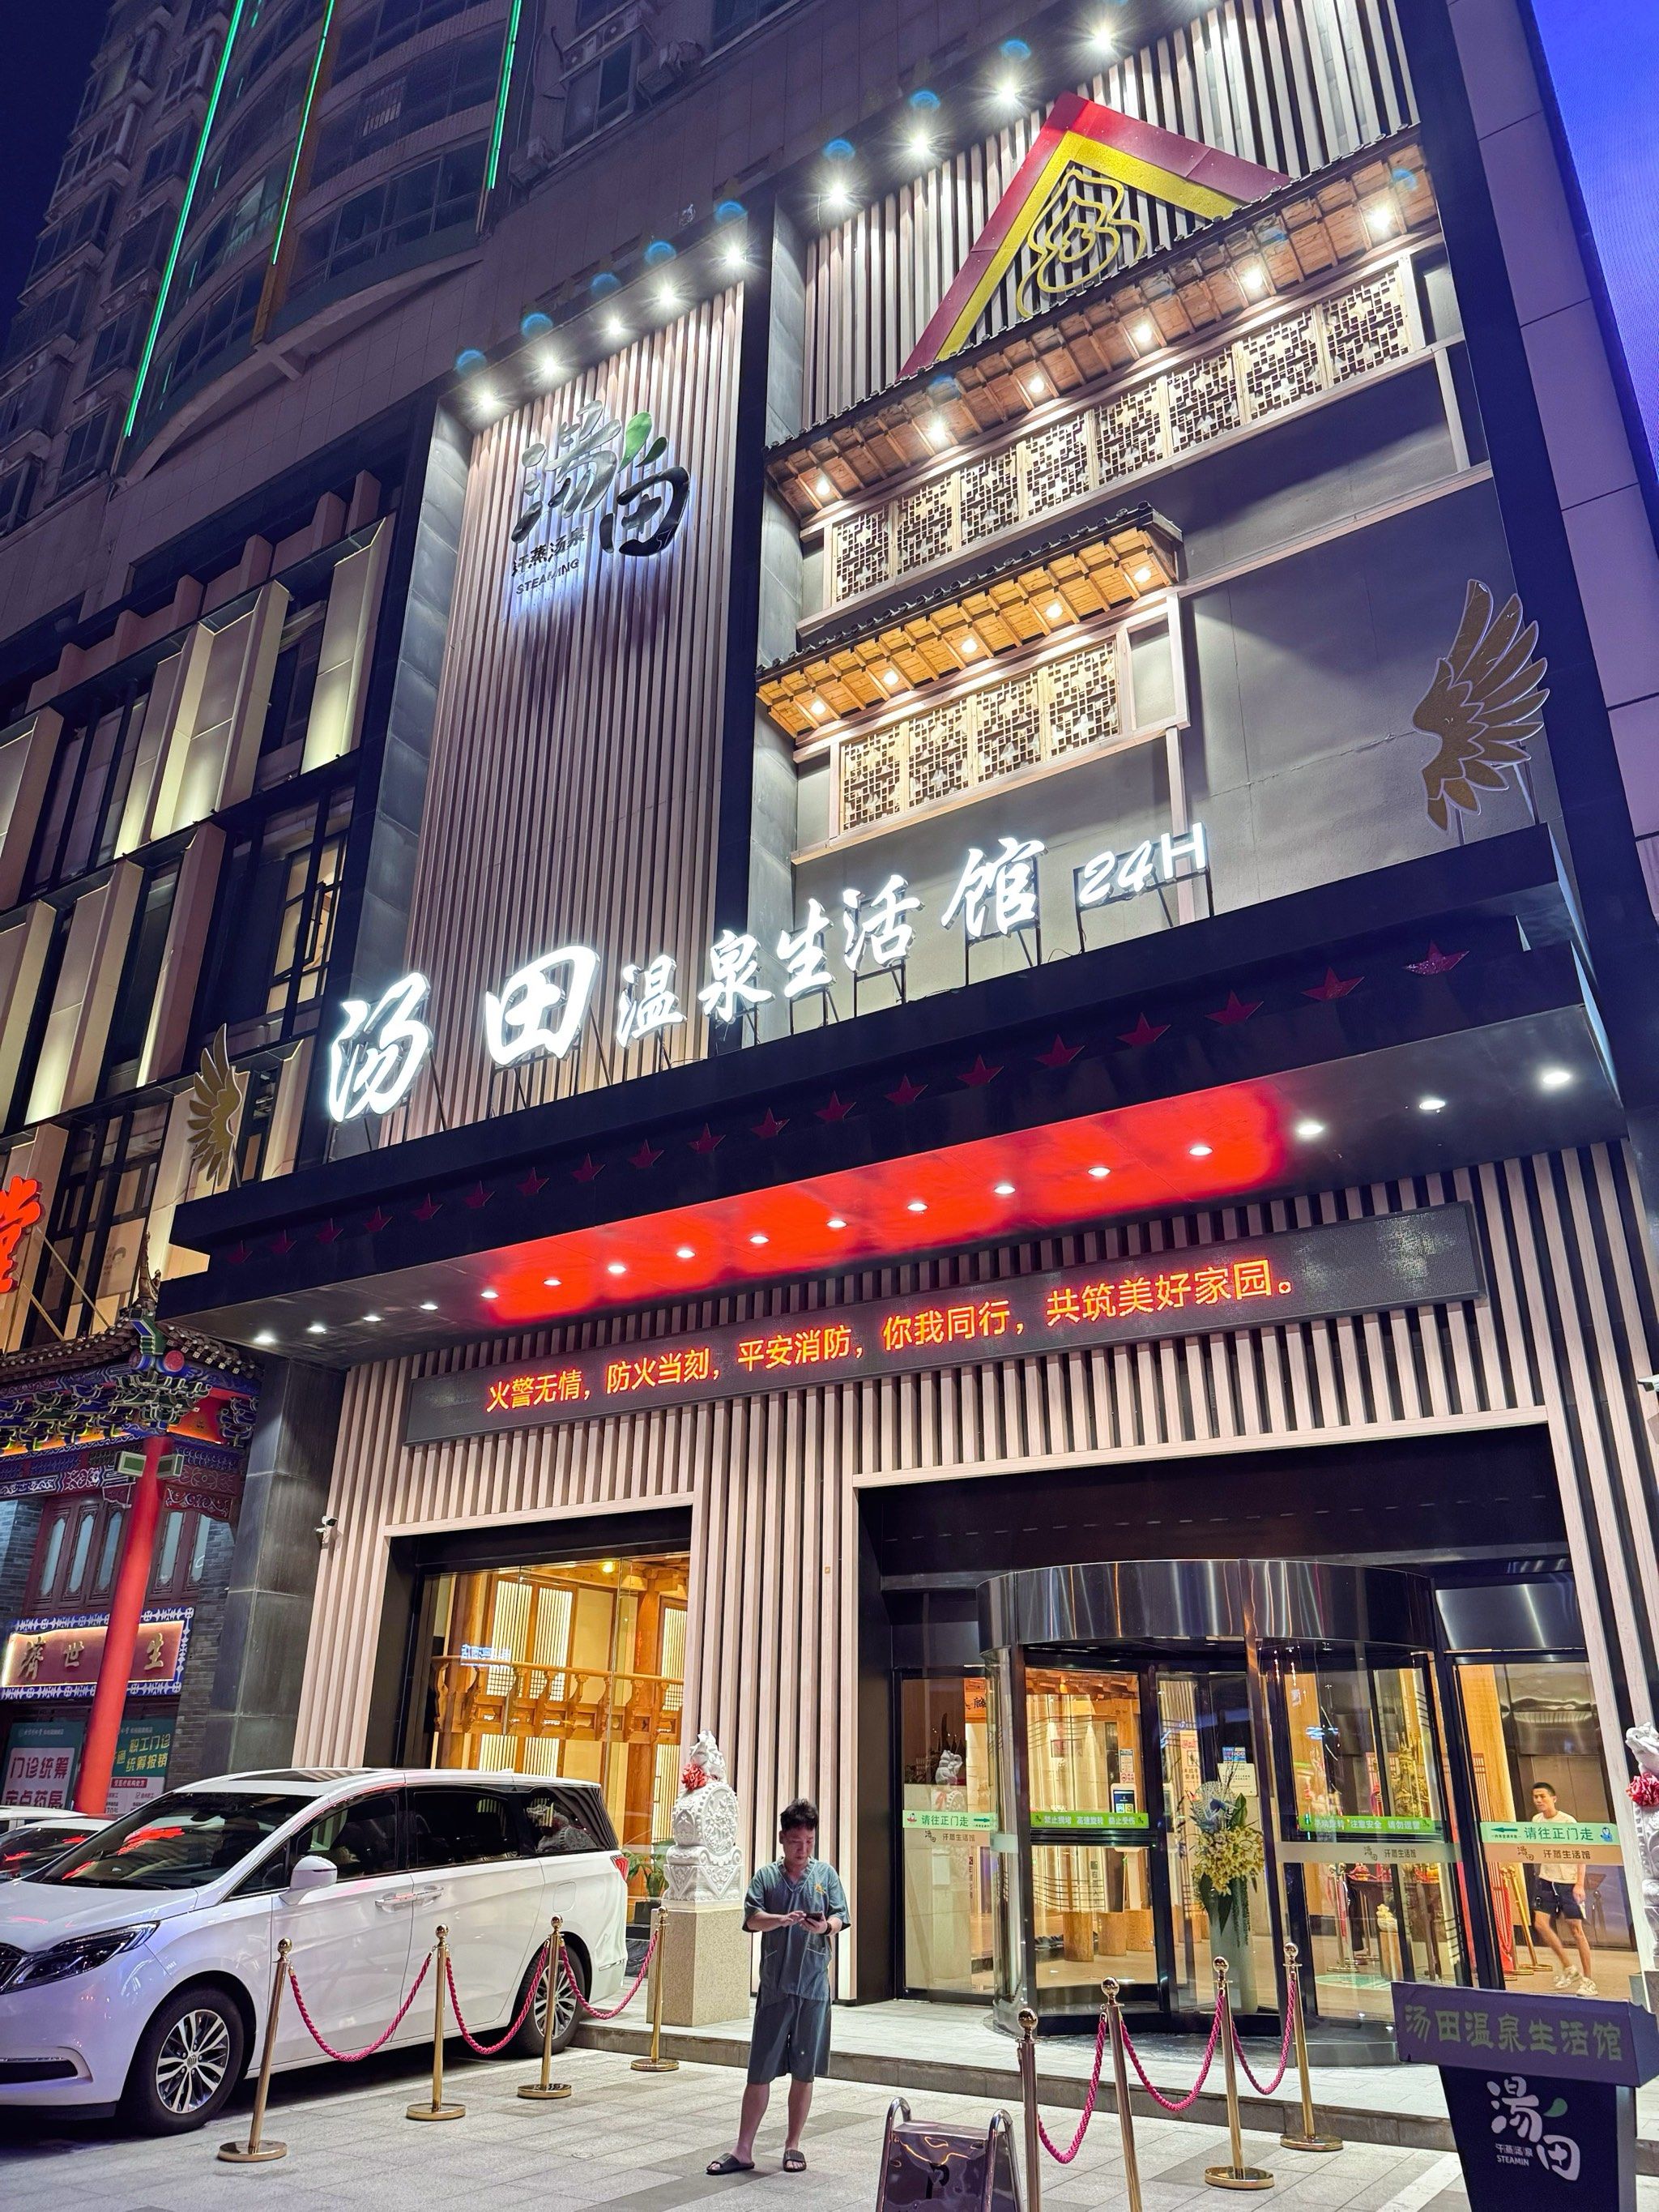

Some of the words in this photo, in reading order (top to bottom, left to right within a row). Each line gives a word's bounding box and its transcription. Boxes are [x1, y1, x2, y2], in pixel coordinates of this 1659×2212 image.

[515, 557, 580, 596] STEAMING
[1076, 822, 1209, 909] 24H
[10, 1757, 69, 1779] 门诊统筹
[921, 1814, 969, 1827] 请往正门走
[1524, 1826, 1594, 1842] 请往正门走
[1543, 1849, 1591, 1860] 汗蒸生活馆
[1405, 2004, 1623, 2061] 汤田温泉生活馆
